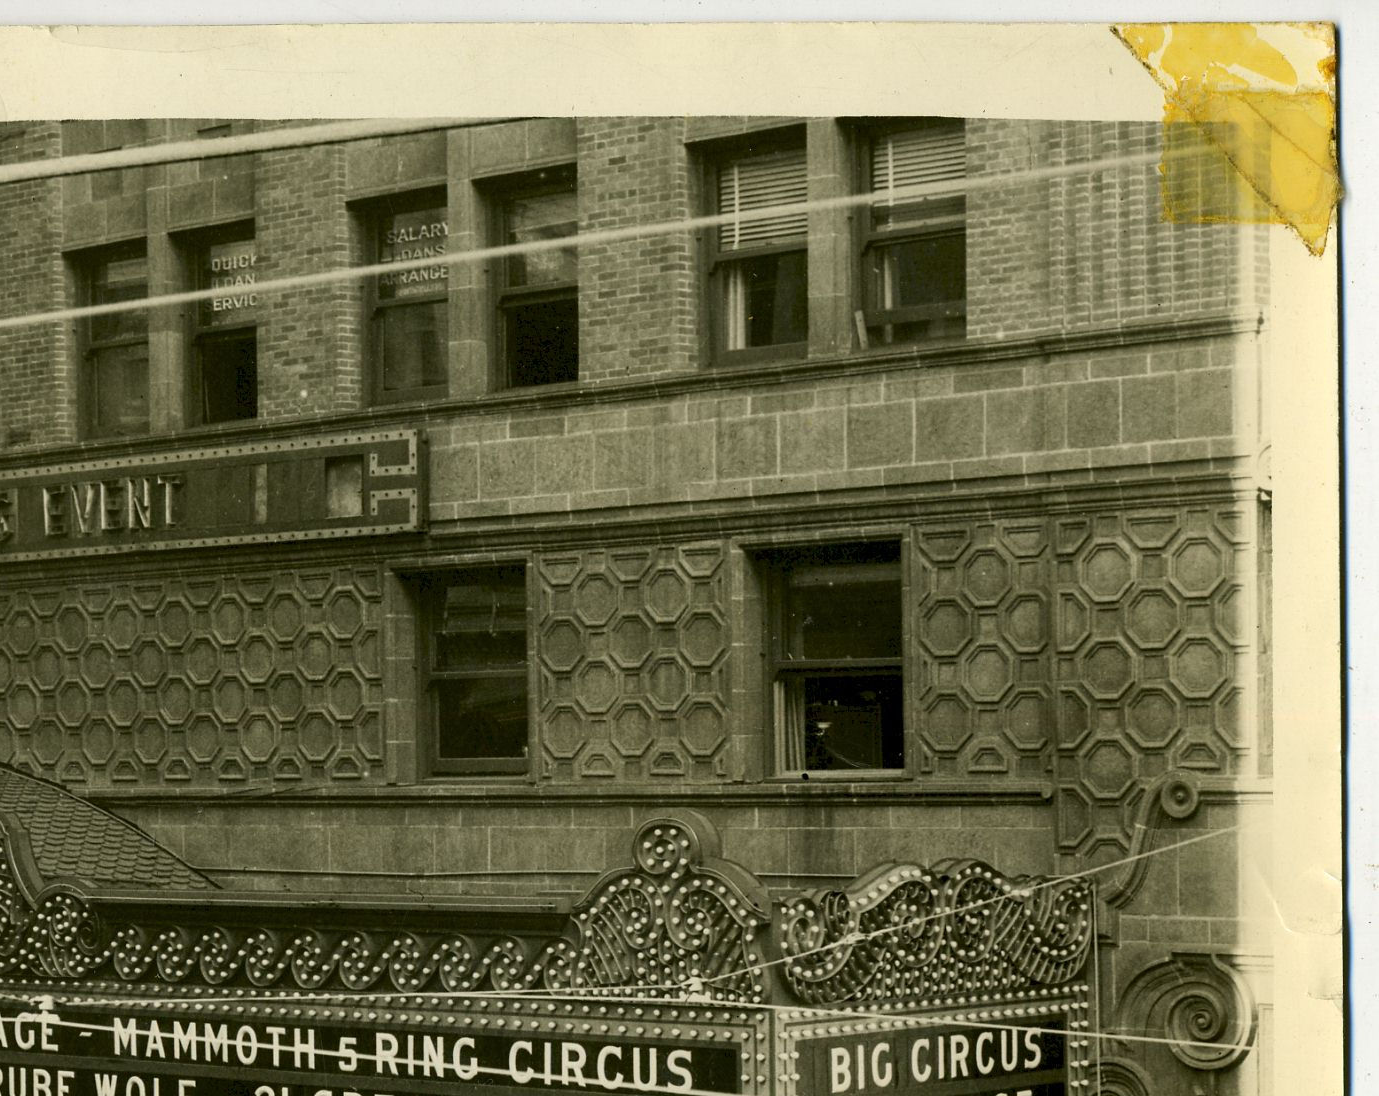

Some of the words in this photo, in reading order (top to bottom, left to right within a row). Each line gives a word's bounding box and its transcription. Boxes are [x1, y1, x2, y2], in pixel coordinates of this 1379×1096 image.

[388, 222, 448, 243] SALARY
[210, 293, 258, 311] ERVIC
[43, 475, 182, 536] EVENT
[113, 1017, 315, 1069] MAMMOTH
[338, 1037, 358, 1072] 5
[375, 1032, 478, 1080] RING
[508, 1040, 693, 1092] CIRCUS
[831, 1042, 892, 1093] BIG
[911, 1028, 1041, 1083] CIRCUS
